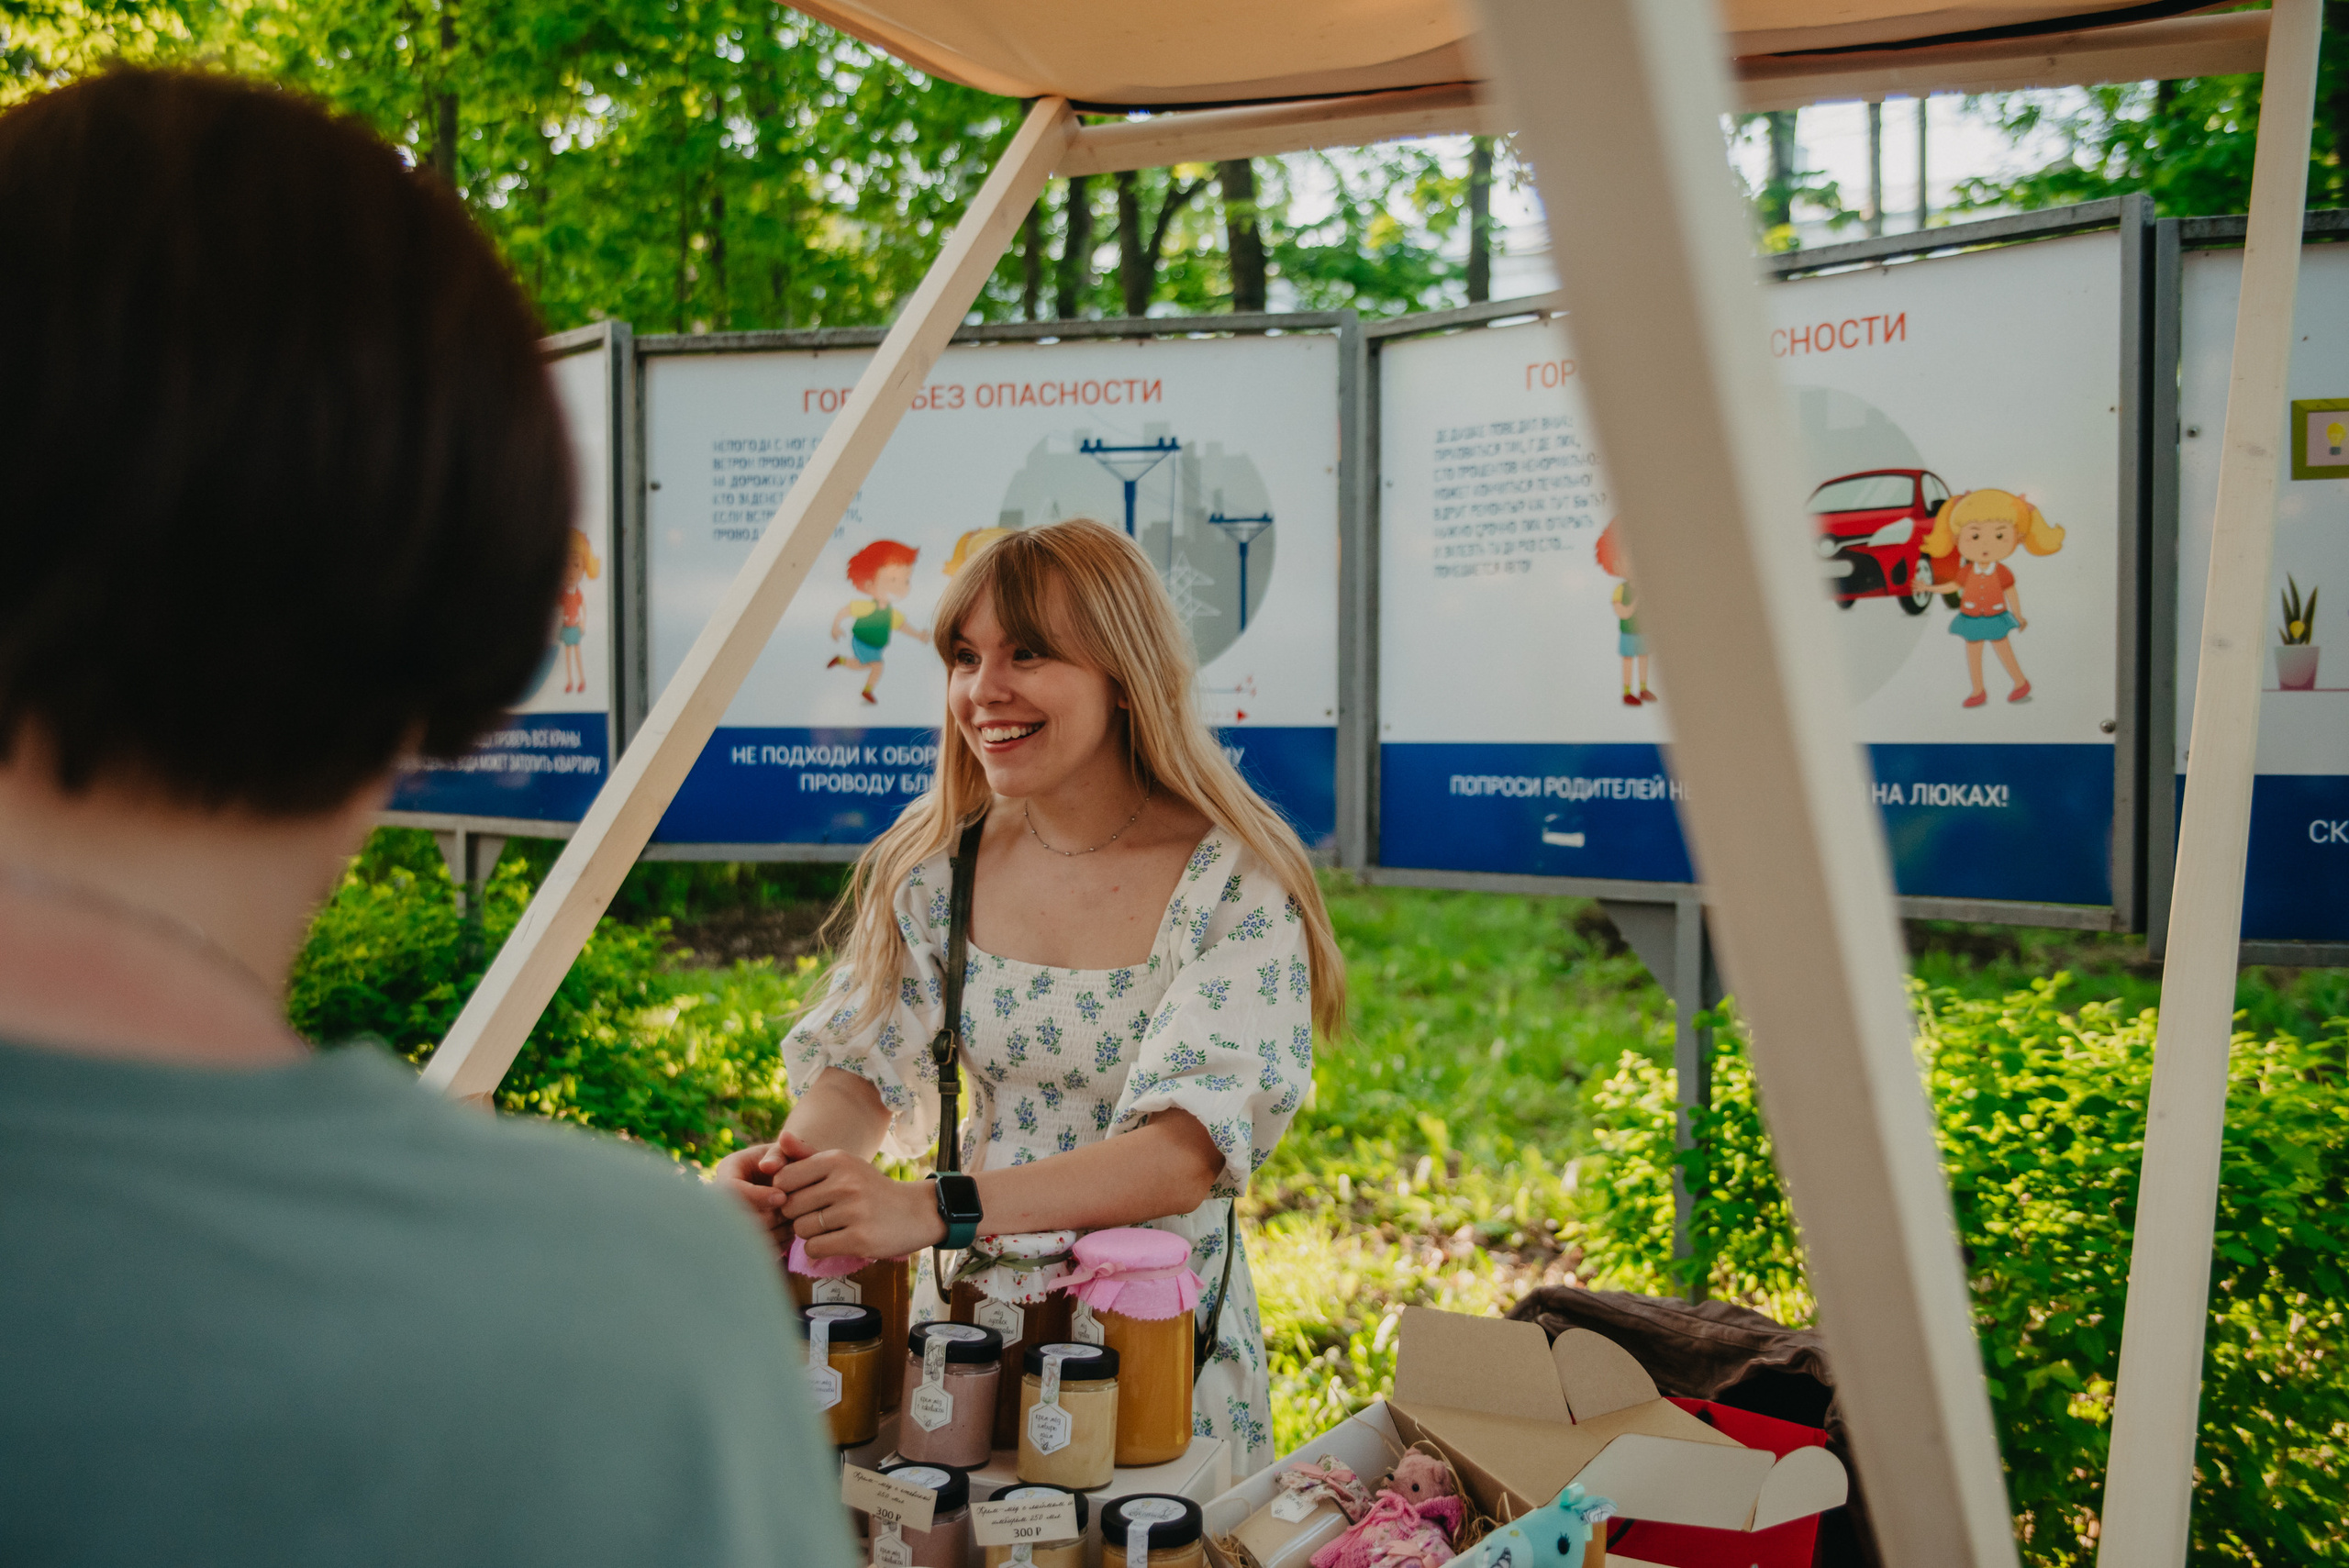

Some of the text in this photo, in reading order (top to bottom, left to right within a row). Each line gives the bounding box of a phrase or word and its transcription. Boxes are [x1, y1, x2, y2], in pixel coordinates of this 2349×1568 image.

[1771, 312, 1906, 358] СНОСТИ
[1526, 359, 1576, 391] ГОР
[974, 378, 1163, 408] ОПАСНОСТИ
[758, 455, 804, 470] ПРОВОД
[713, 528, 759, 542] ПРОВОД
[732, 746, 756, 764] НЕ
[762, 745, 860, 768] ПОДХОДИ
[865, 746, 878, 765] К
[800, 773, 896, 795] ПРОВОДУ
[1450, 774, 1541, 796] ПОПРОСИ
[1544, 774, 1665, 801] РОДИТЕЛЕЙ
[1872, 783, 2009, 807] НА ЛЮКАХ!
[876, 1507, 894, 1519] 300
[1014, 1528, 1033, 1538] 300
